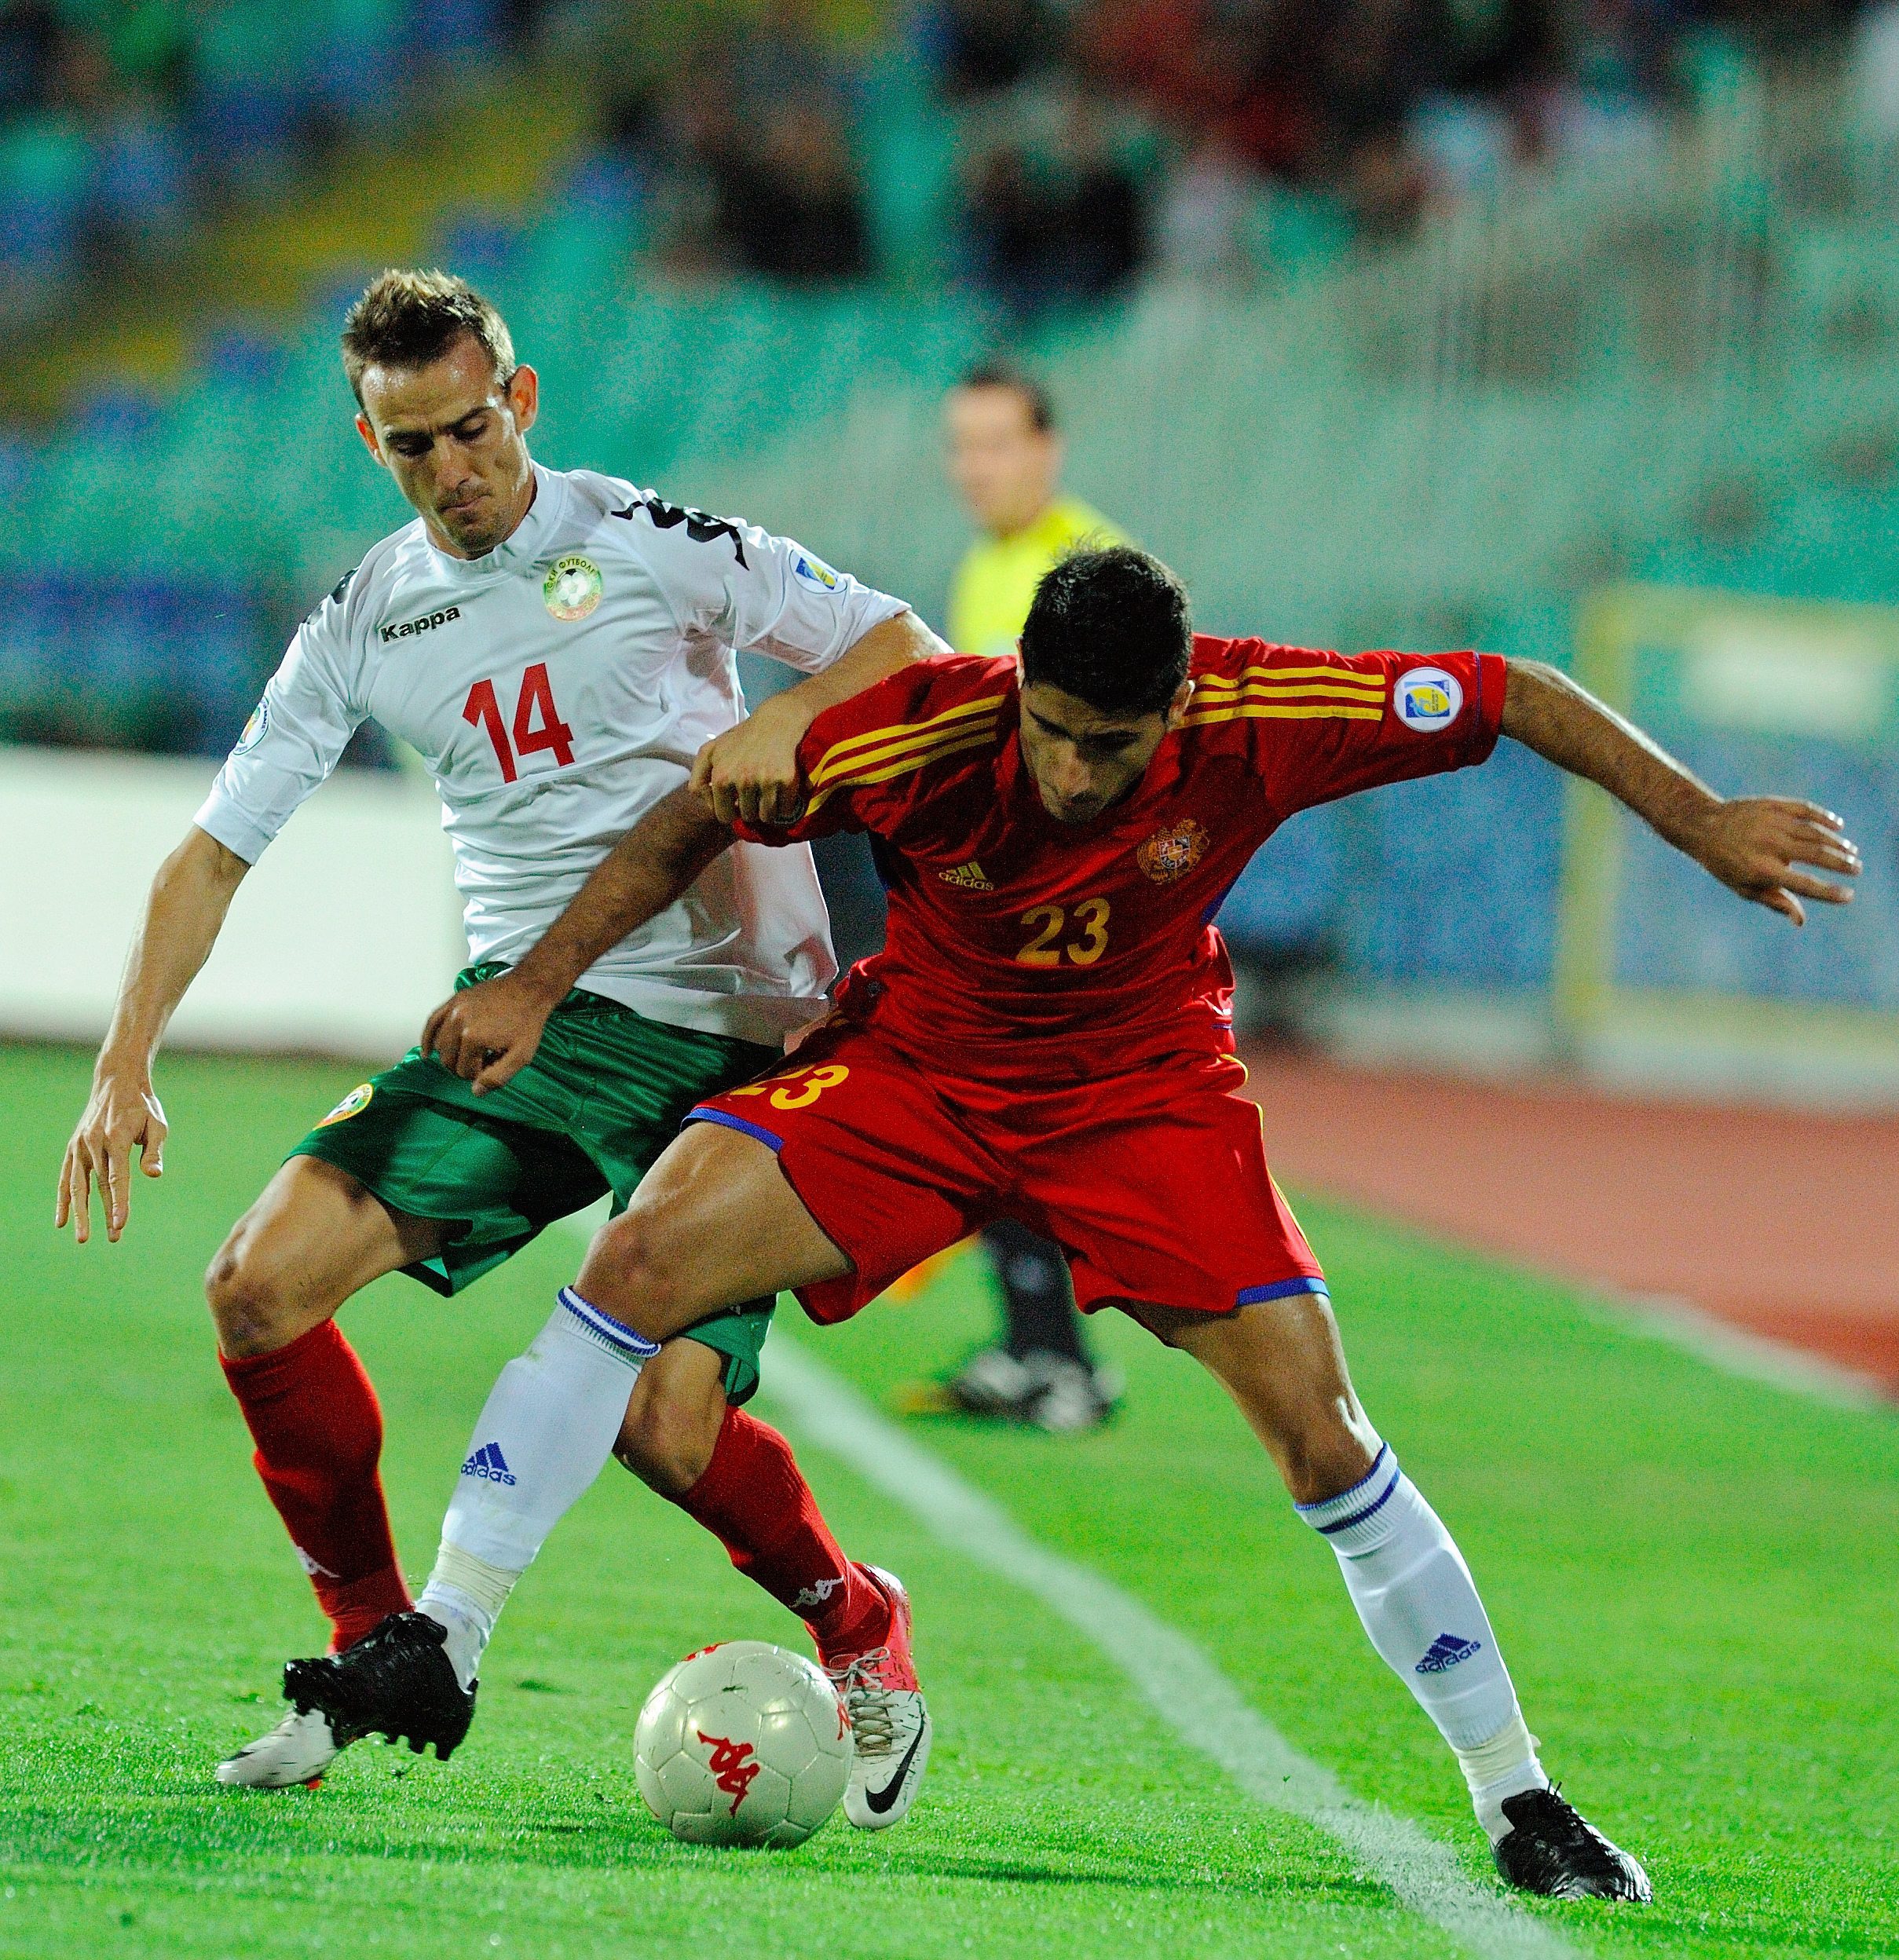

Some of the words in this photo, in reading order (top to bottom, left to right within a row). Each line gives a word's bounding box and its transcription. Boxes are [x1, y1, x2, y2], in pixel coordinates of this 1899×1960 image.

[381, 606, 461, 642] Kappa
[462, 663, 575, 784] 14
[939, 872, 994, 891] adidas
[1015, 898, 1111, 966] 23
[461, 1462, 517, 1486] adidas
[1414, 1640, 1481, 1673] adidas
